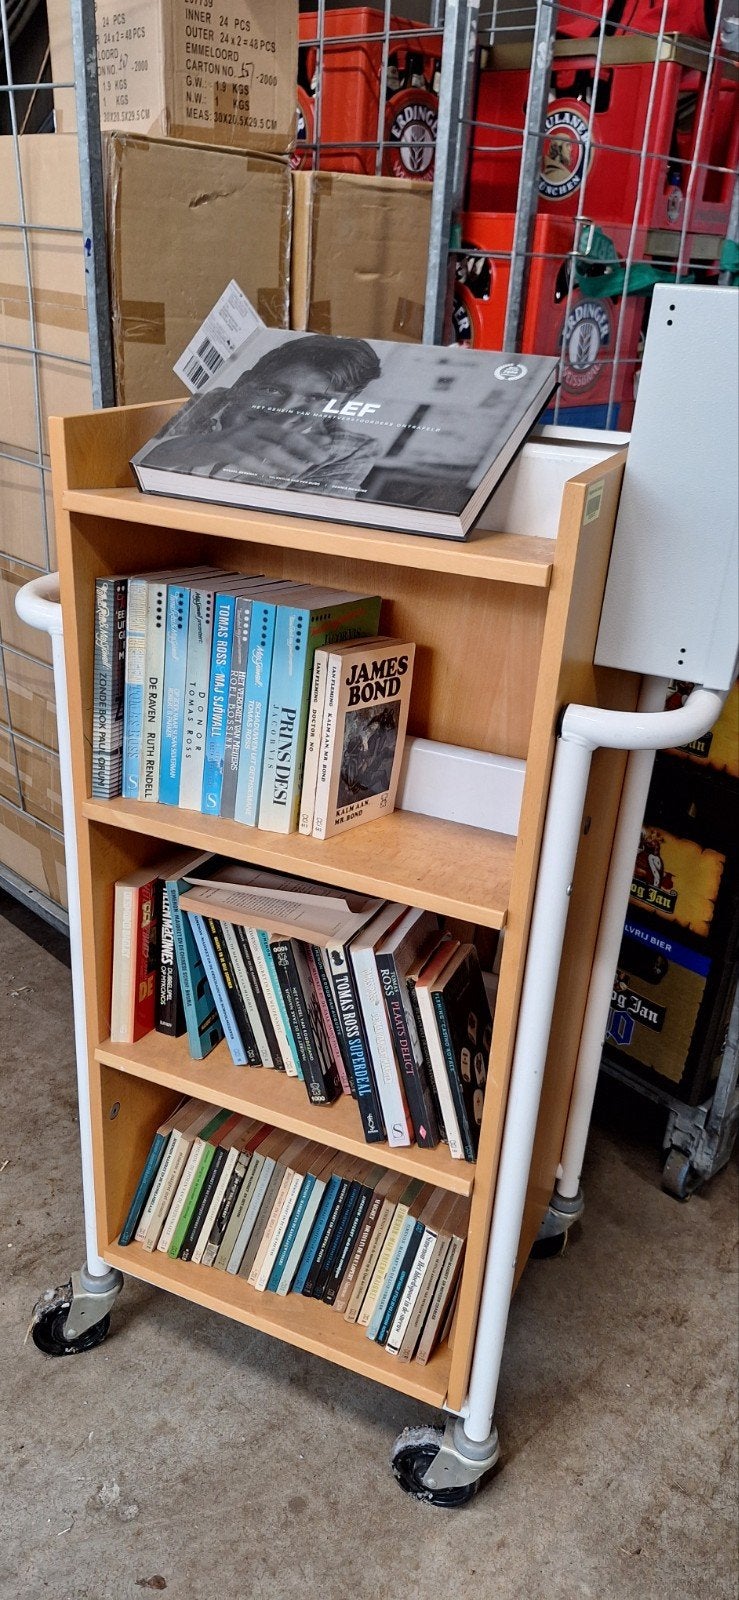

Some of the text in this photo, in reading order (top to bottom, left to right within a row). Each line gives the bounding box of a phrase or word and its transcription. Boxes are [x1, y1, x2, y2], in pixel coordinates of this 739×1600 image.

[186, 8, 251, 32] INNER 24 PCS
[186, 25, 214, 41] OUTER
[186, 42, 239, 62] EMMELOORD
[186, 59, 220, 75] CARTON
[232, 83, 249, 96] KGS
[233, 99, 250, 111] KGS
[322, 399, 381, 417] LEF
[216, 604, 229, 637] TOMAS
[215, 640, 227, 664] ROSS
[213, 673, 225, 692] MAJ
[346, 655, 409, 686] JAMES
[327, 679, 335, 706] FLEMING
[348, 677, 401, 706] BOND
[185, 682, 196, 759] TOMAS ROSS
[195, 692, 205, 751] DONOR
[210, 695, 225, 737] SJÖWALL
[244, 699, 254, 749] TOMAS ROSS
[250, 701, 260, 750] SCHADUWEN
[309, 708, 317, 737] DOCTOR
[143, 677, 158, 797] DE RAVEN RUTH RENDELL
[233, 724, 241, 738] VAN
[249, 751, 257, 764] UIT
[272, 707, 296, 806] PRINS DESI
[308, 742, 314, 751] NO
[336, 804, 357, 816] KALM
[346, 809, 363, 822] BOND
[647, 889, 671, 908] Jan
[650, 937, 672, 953] BIER
[160, 965, 166, 974] OP
[379, 967, 394, 996] ROSS
[389, 971, 399, 992] TOMAS
[629, 995, 659, 1024] Jan
[334, 975, 371, 1096] TOMAS ROSS SUPERDEAL
[390, 1000, 414, 1076] PLAATS DELICT
[439, 1023, 449, 1047] CASINO
[416, 1260, 425, 1271] Het
[405, 1270, 421, 1300] bloedspoor
